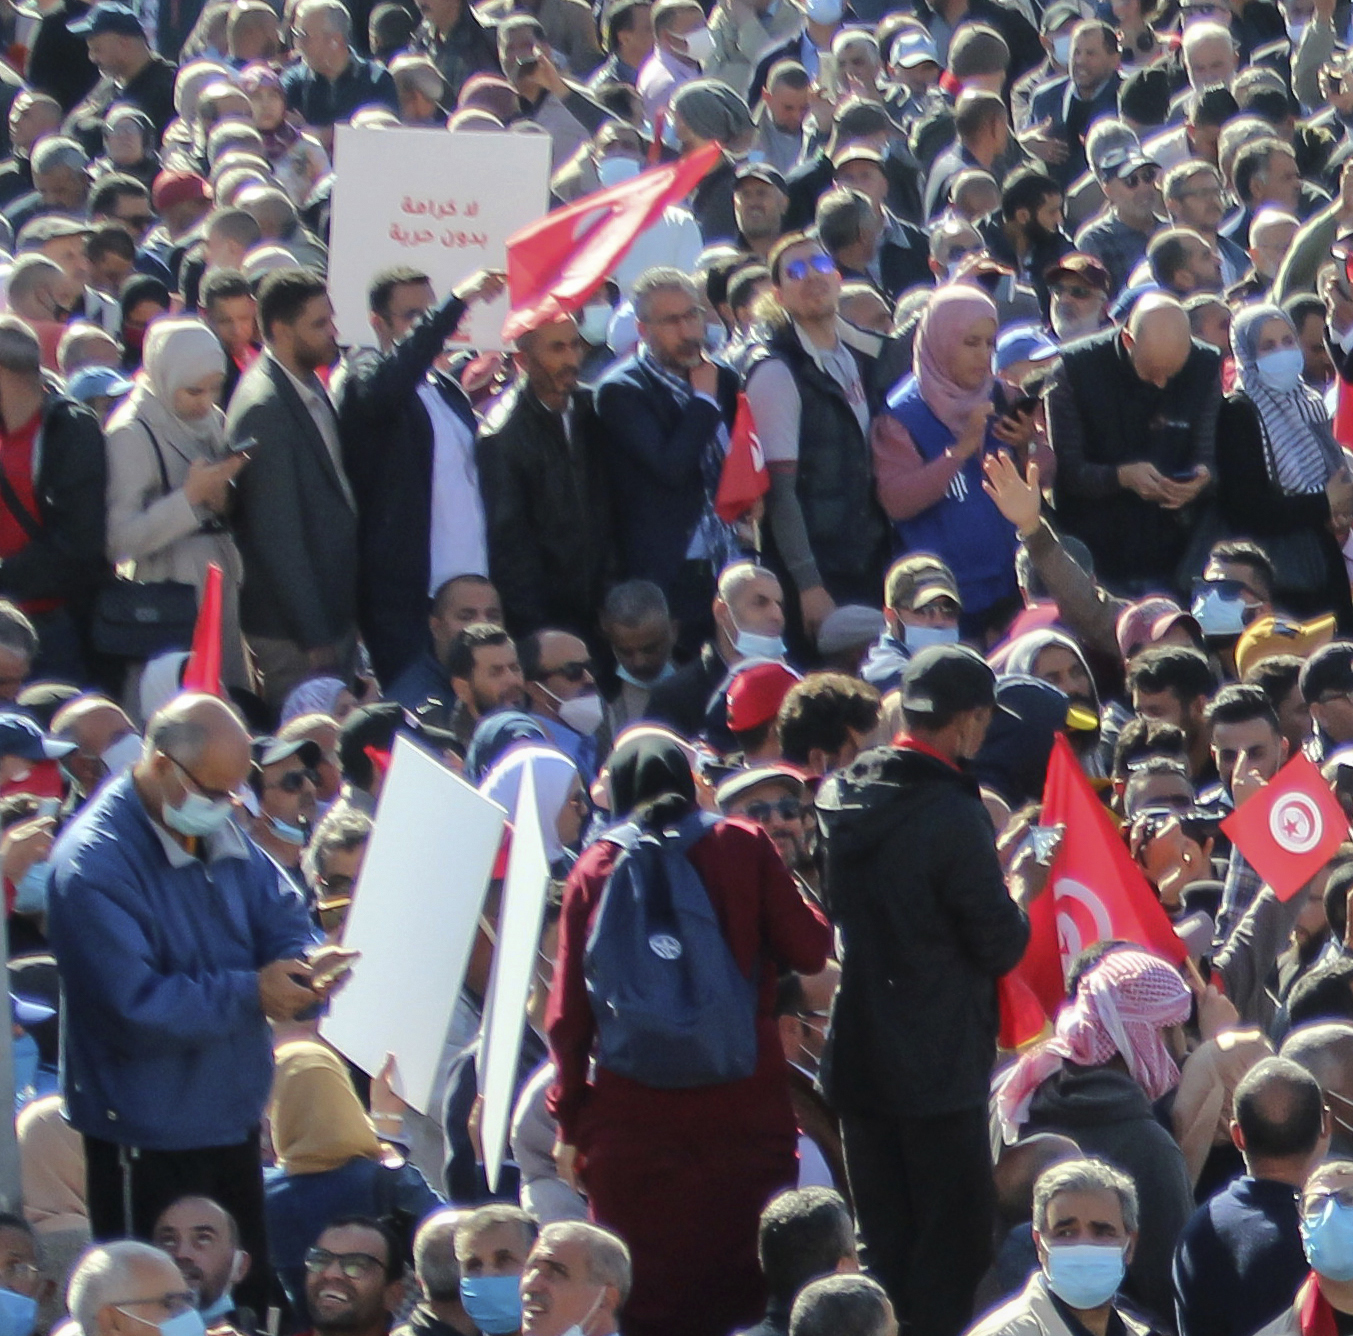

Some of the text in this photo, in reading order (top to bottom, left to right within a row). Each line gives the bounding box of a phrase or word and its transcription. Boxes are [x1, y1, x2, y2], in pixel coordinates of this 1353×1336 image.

[401, 195, 480, 220] لا كرامة
[389, 221, 489, 250] بدون حرية
